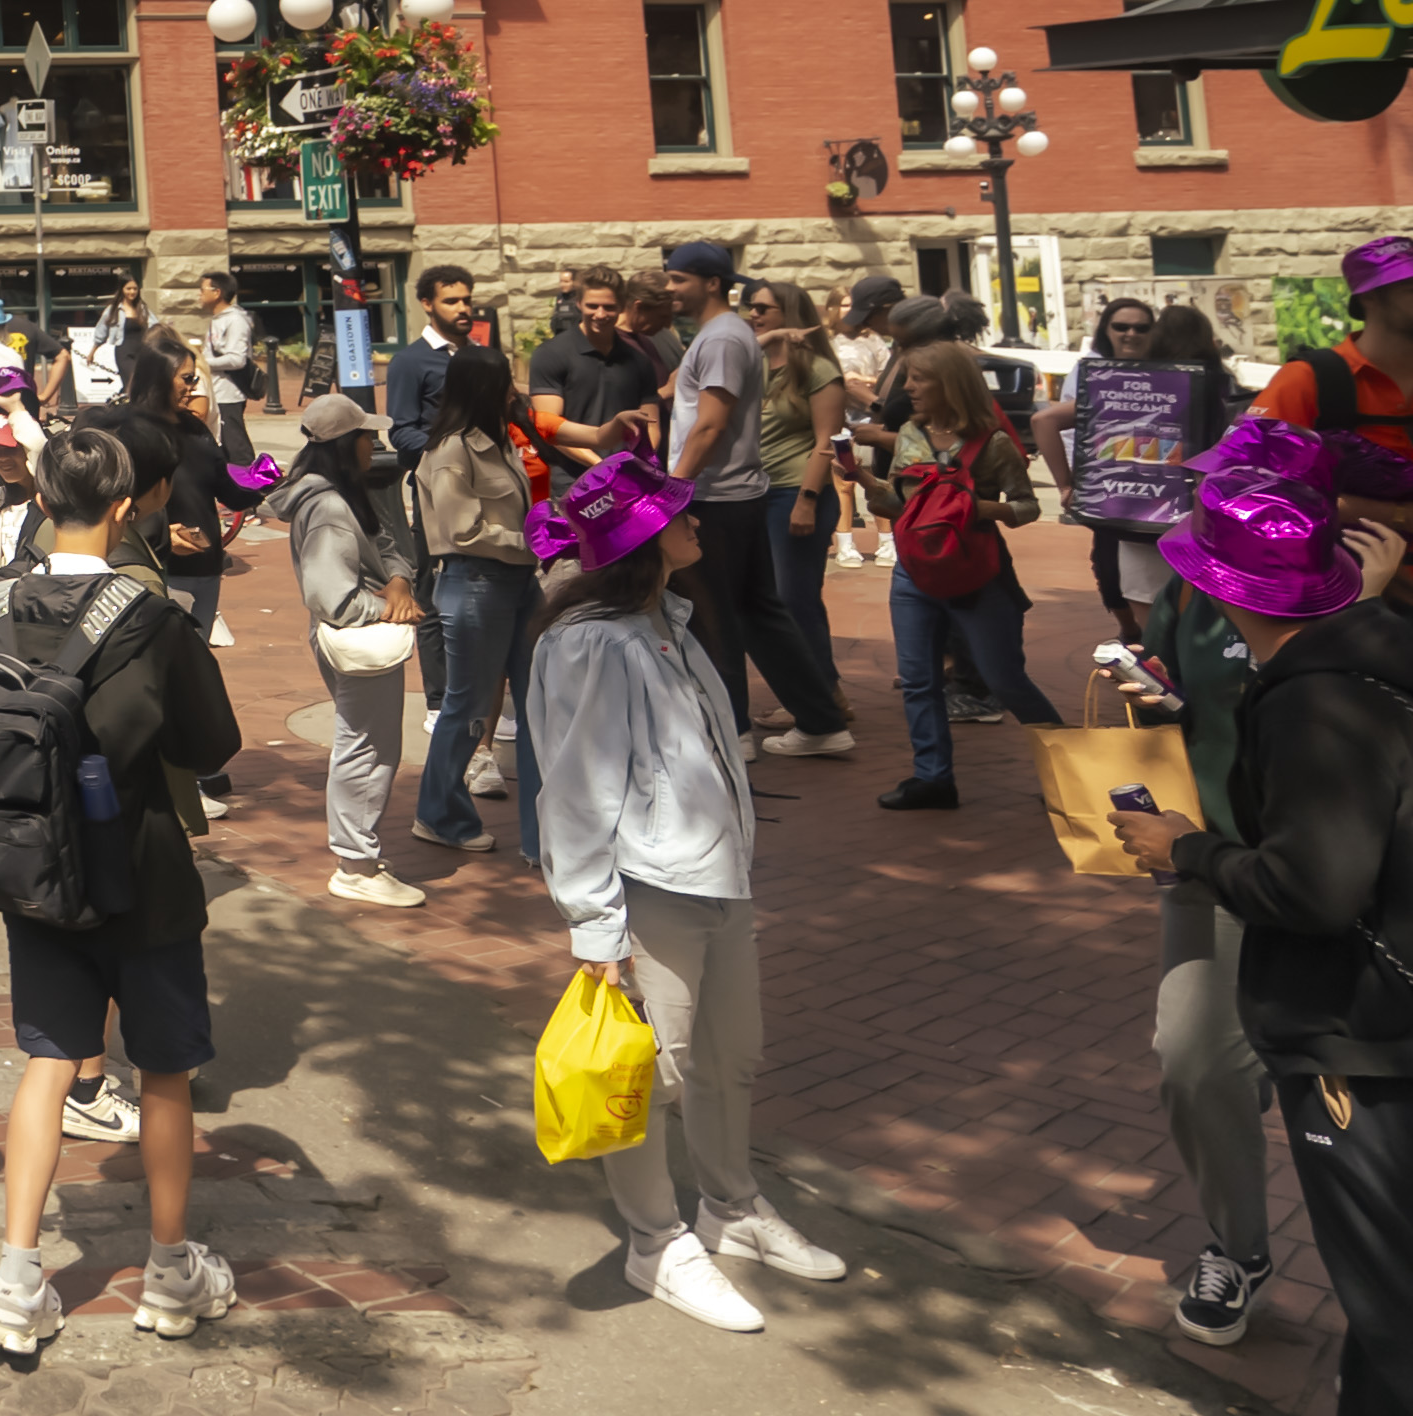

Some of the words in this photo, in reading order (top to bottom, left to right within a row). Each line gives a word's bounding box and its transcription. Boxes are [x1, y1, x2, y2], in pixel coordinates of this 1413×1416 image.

[299, 89, 323, 111] ONE
[326, 85, 346, 107] WAY
[3, 146, 27, 156] Visit
[45, 144, 81, 156] Online
[311, 150, 334, 179] NO
[57, 173, 92, 186] SCOOP
[307, 183, 342, 212] EXIT
[344, 316, 357, 364] GASTOWN
[1123, 380, 1152, 392] FOR
[1098, 390, 1178, 404] TONIGHT'S
[1103, 401, 1172, 414] PREGAME
[1102, 478, 1167, 498] VIZZY
[578, 491, 616, 519] VIZZY
